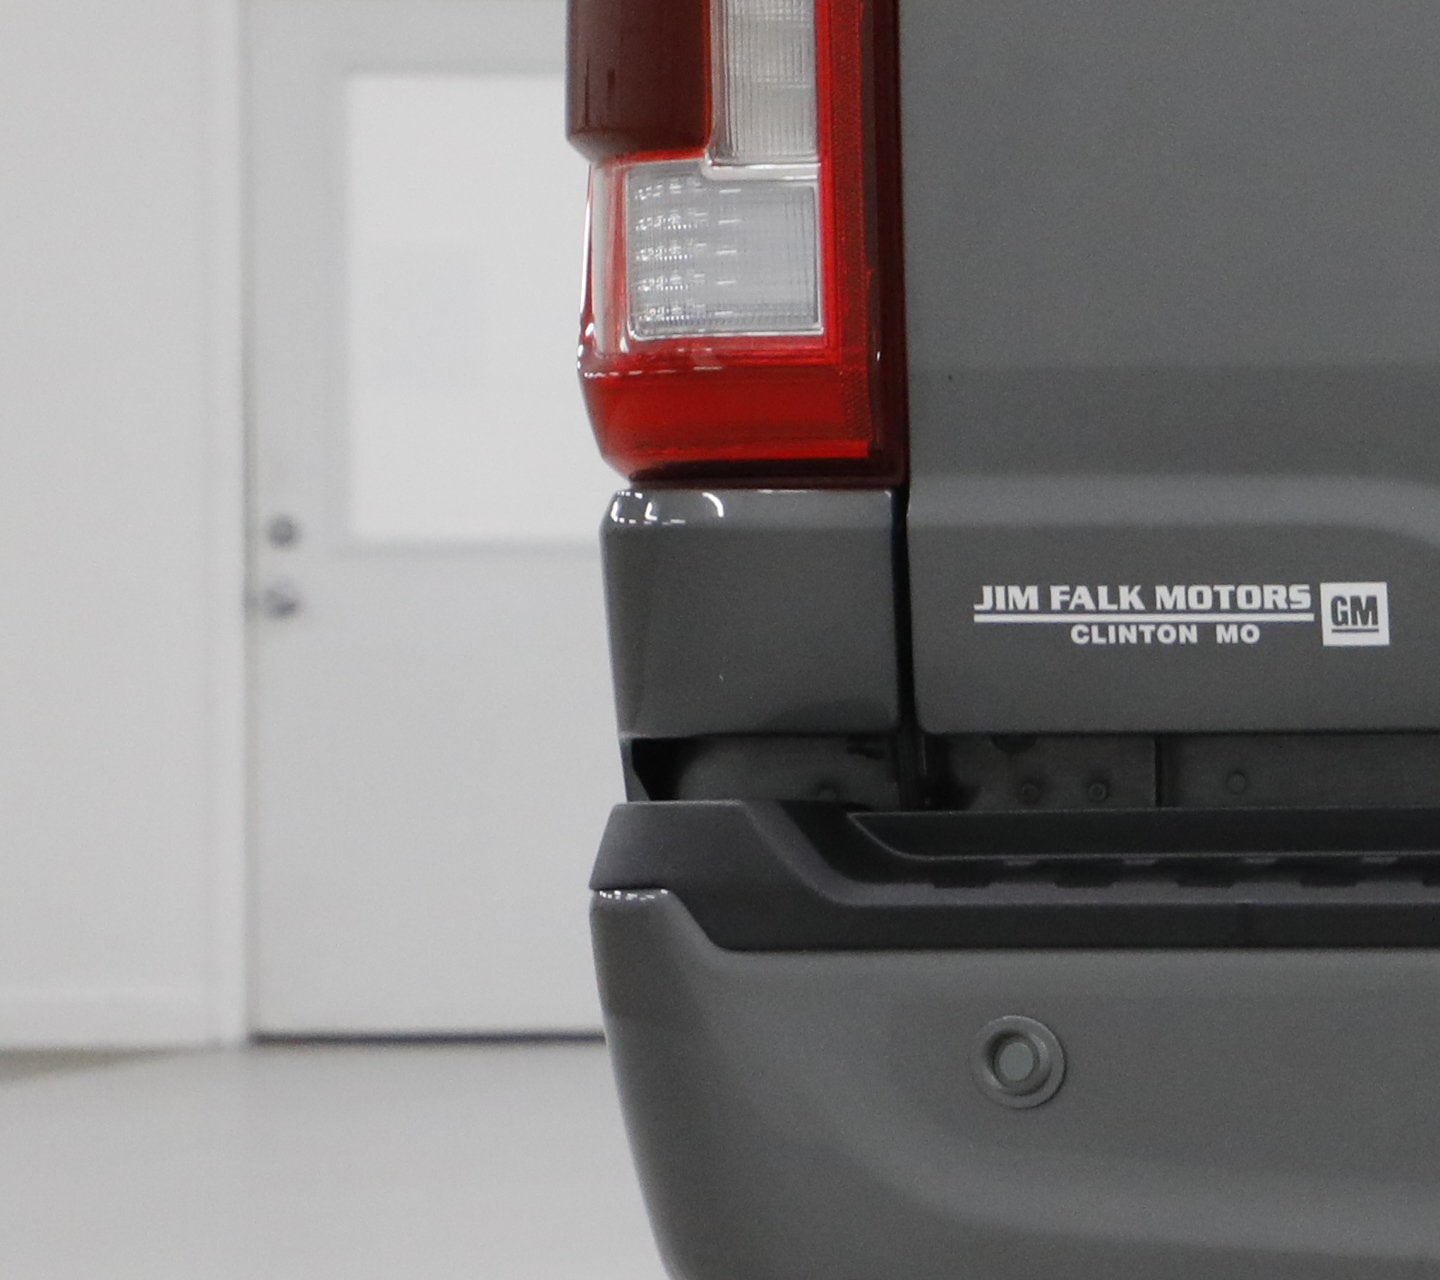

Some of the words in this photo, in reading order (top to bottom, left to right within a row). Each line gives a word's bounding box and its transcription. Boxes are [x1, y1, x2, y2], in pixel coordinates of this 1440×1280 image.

[973, 584, 1039, 611] JIM
[1050, 584, 1146, 611] FALK
[1155, 583, 1312, 611] MOTORS
[1330, 595, 1380, 626] GM
[1070, 623, 1198, 644] CLINTON
[1216, 623, 1261, 644] MO
